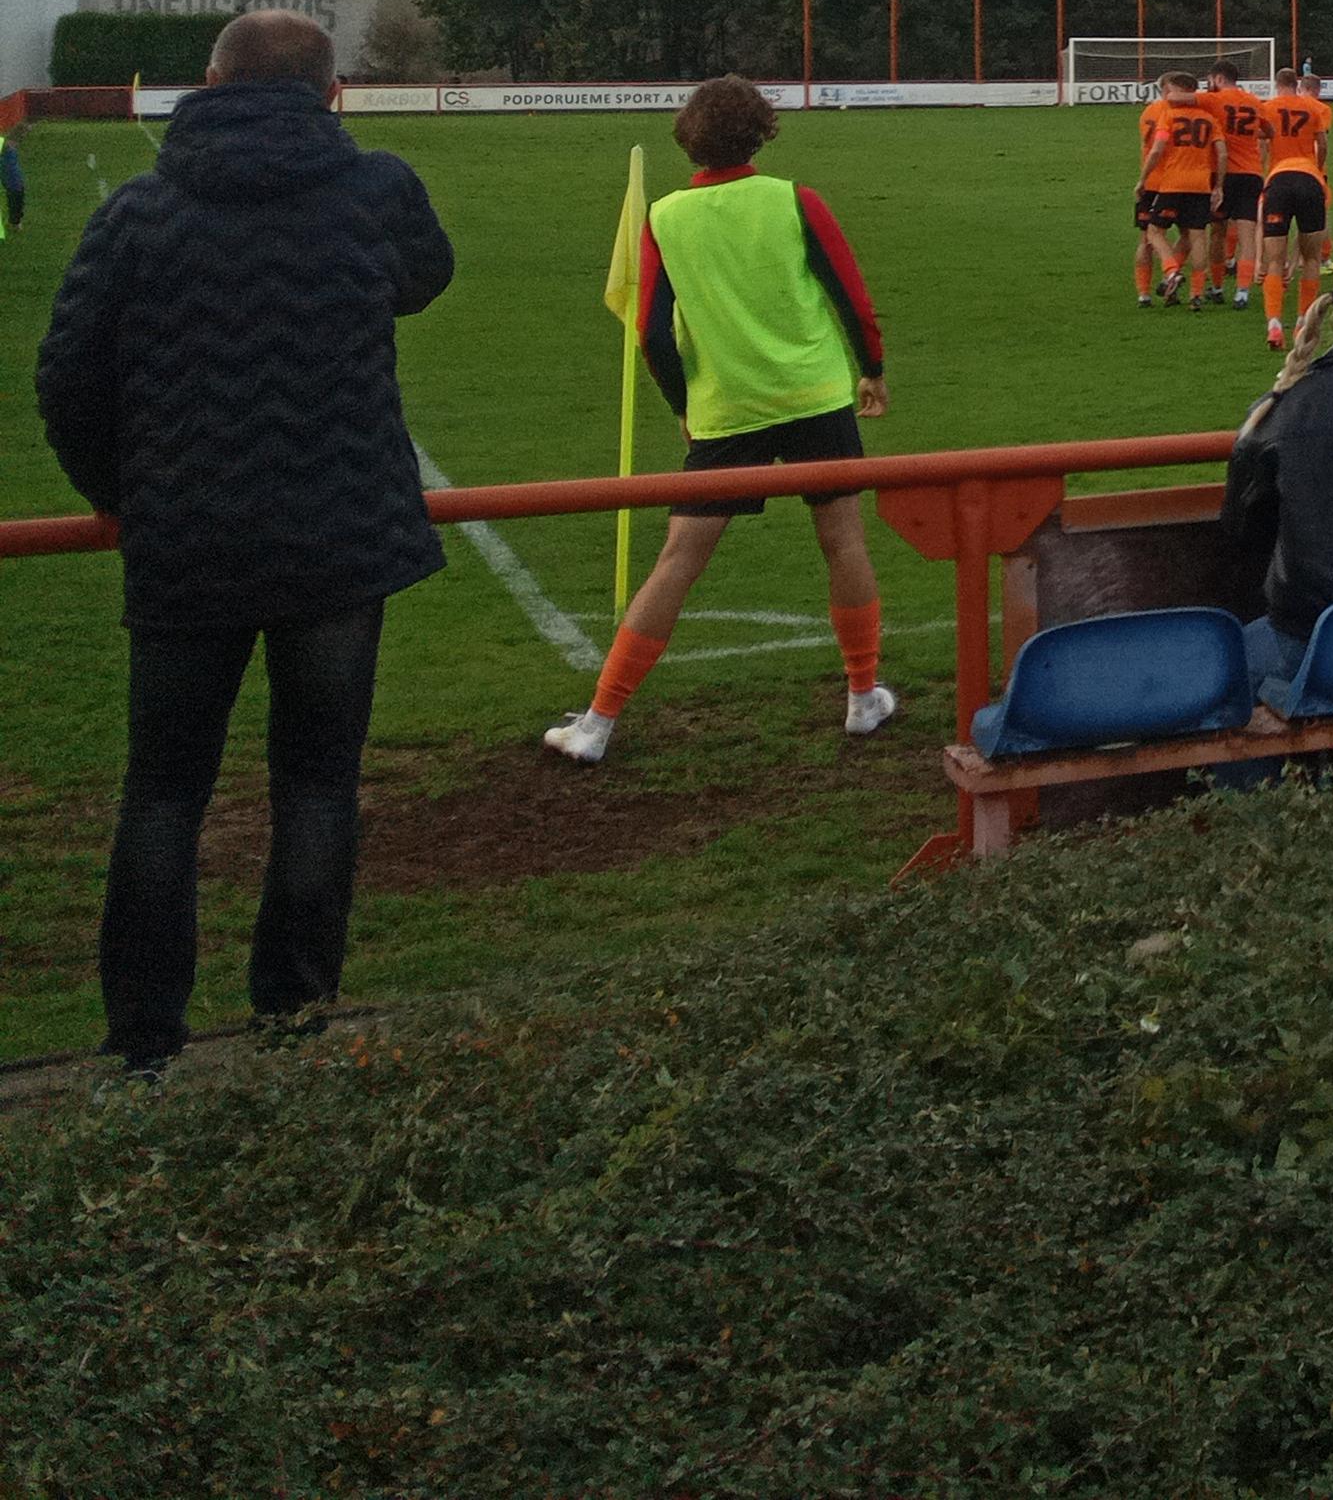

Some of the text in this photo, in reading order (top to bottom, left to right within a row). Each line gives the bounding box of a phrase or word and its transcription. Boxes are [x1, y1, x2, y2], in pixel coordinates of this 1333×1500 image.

[502, 94, 613, 105] PODPORUJEME
[616, 93, 660, 105] SPORT
[664, 92, 675, 104] A
[1172, 116, 1213, 149] 20
[1224, 104, 1256, 136] 12
[1277, 108, 1311, 138] 17
